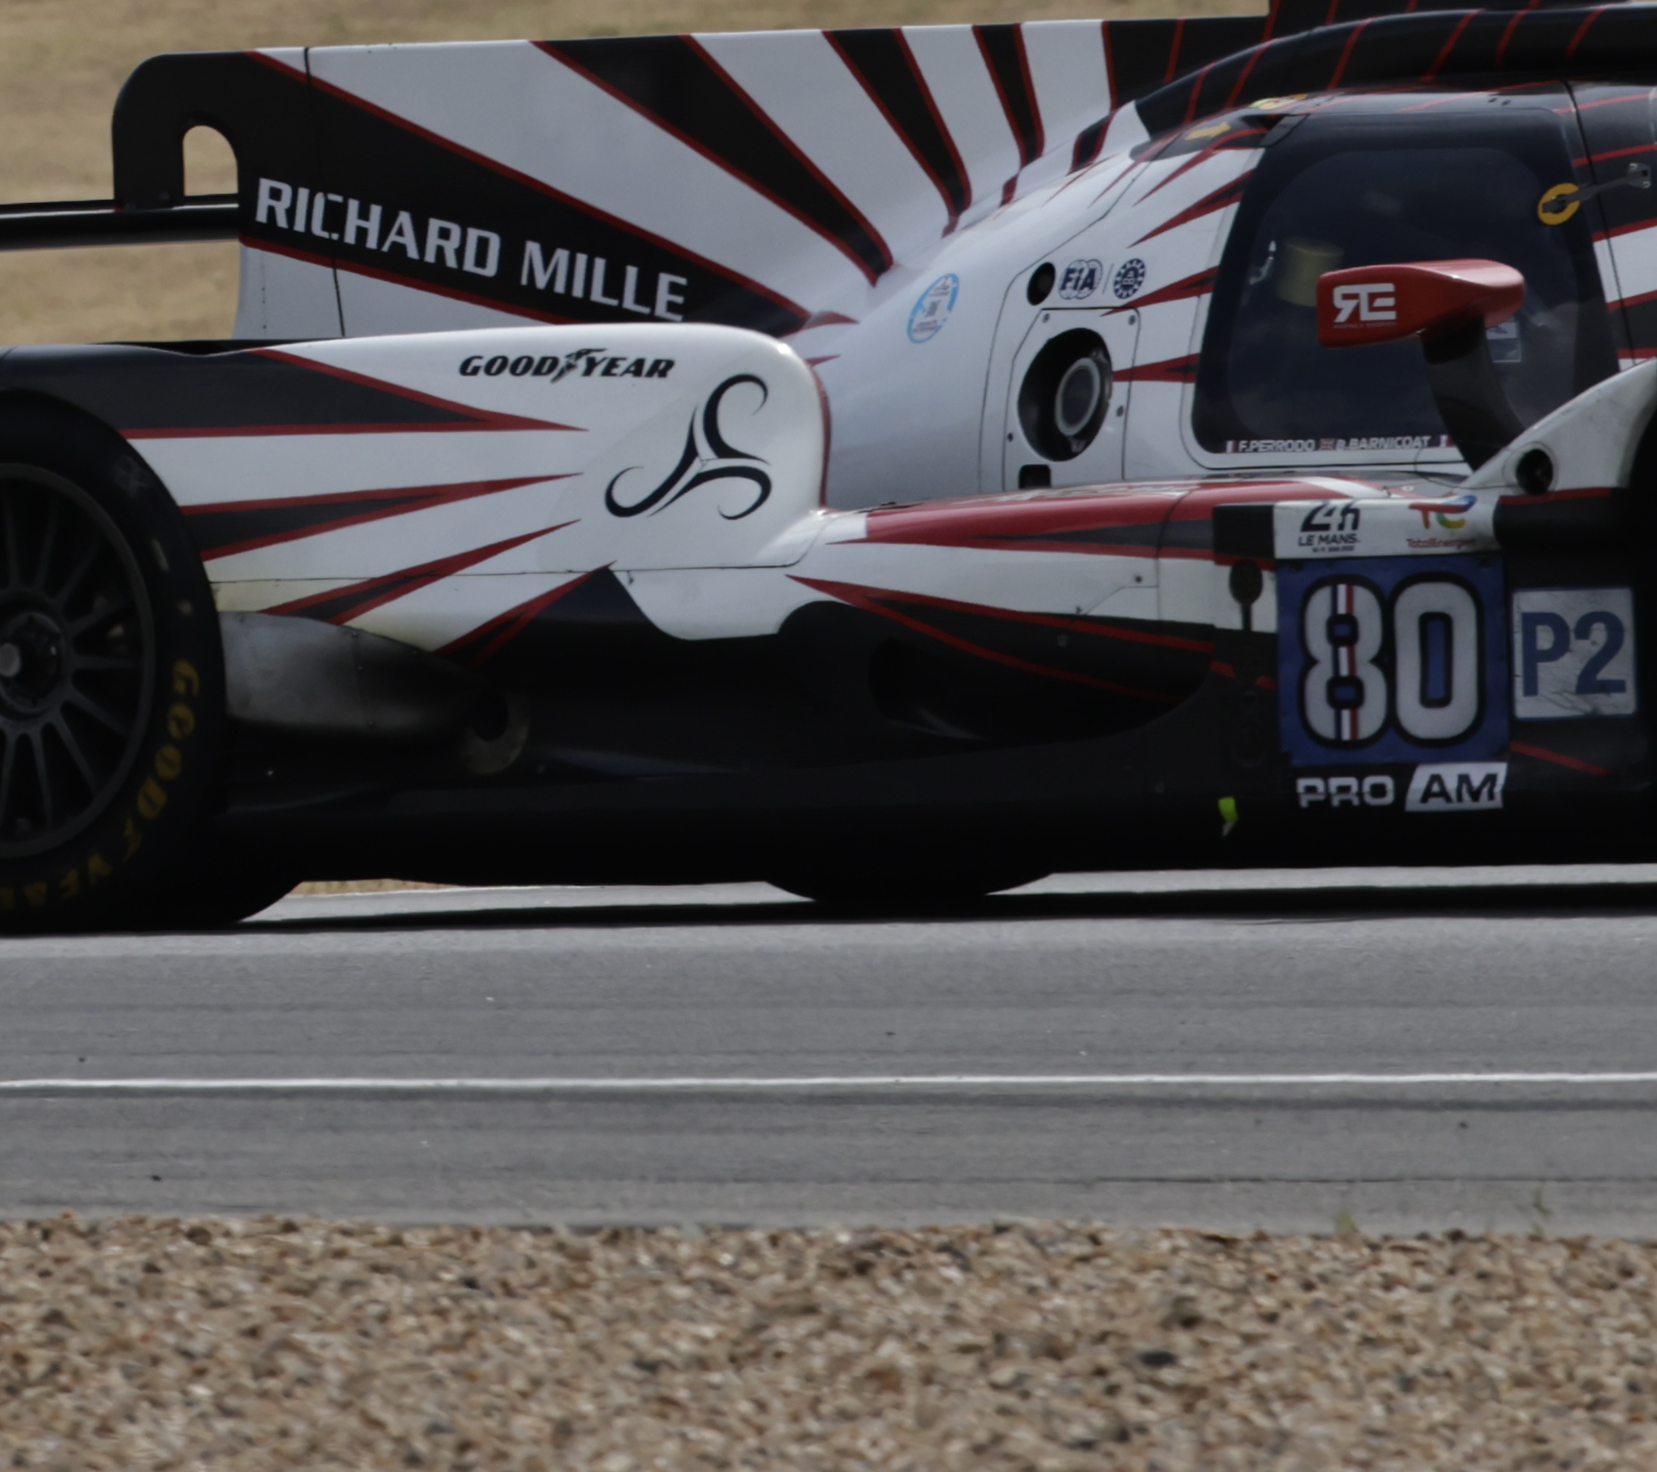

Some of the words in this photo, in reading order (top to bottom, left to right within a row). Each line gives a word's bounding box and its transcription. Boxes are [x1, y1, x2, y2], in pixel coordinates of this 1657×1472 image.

[254, 176, 502, 279] RICHARD
[520, 239, 689, 323] MILLE
[457, 348, 676, 384] GOODYEAR
[1238, 439, 1315, 453] F.PERRODO
[1298, 535, 1313, 547] LE
[1317, 534, 1358, 546] MANS
[1301, 576, 1482, 746] 80
[1520, 611, 1626, 697] P2
[1296, 775, 1395, 808] PRO
[1420, 772, 1499, 804] AM
